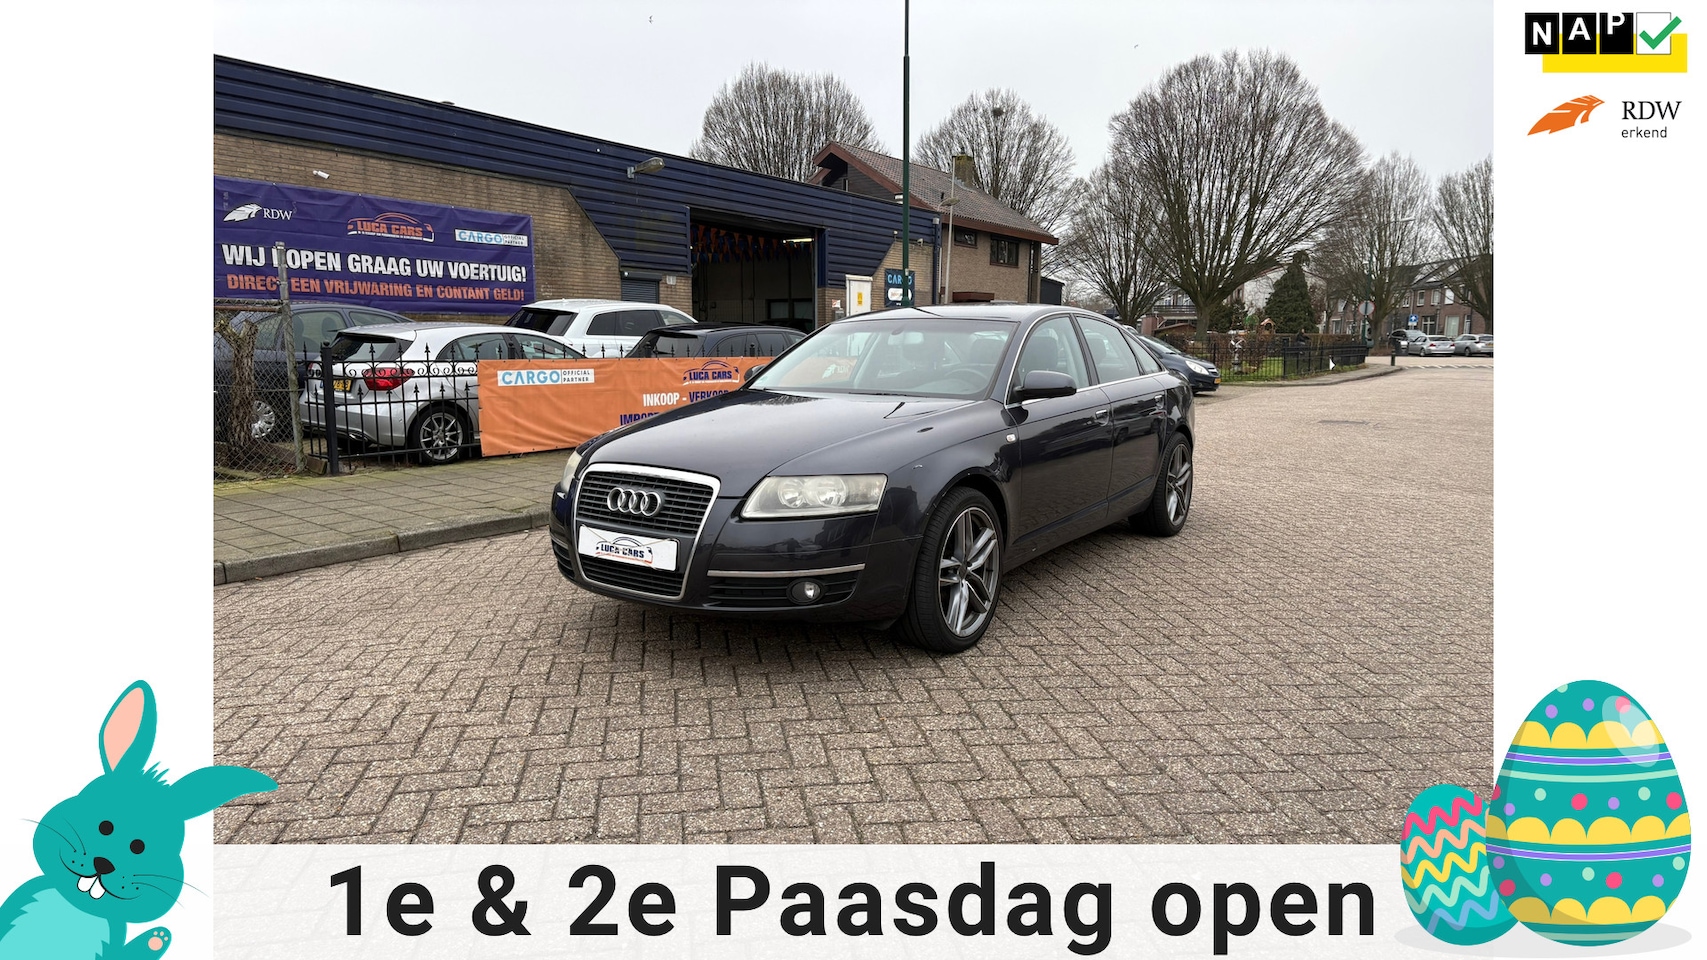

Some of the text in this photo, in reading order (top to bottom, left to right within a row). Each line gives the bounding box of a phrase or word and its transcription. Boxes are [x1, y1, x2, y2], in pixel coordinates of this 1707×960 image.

[263, 207, 293, 220] RDW
[357, 220, 388, 233] LUCA
[391, 224, 423, 237] CARS
[458, 231, 503, 243] CARGO
[221, 244, 265, 266] WIJ
[347, 254, 411, 276] GRAAG
[415, 259, 444, 278] UW
[447, 262, 527, 282] VOERTUIG!
[887, 274, 912, 285] CARO
[226, 274, 525, 301] DIREC EEN VRIJWARING EN CONTANT GELD!
[502, 370, 560, 384] CARGO
[689, 370, 732, 380] LUCA CARS
[643, 392, 680, 407] INKOOP
[601, 543, 620, 554] LUCA
[622, 548, 644, 558] CARS
